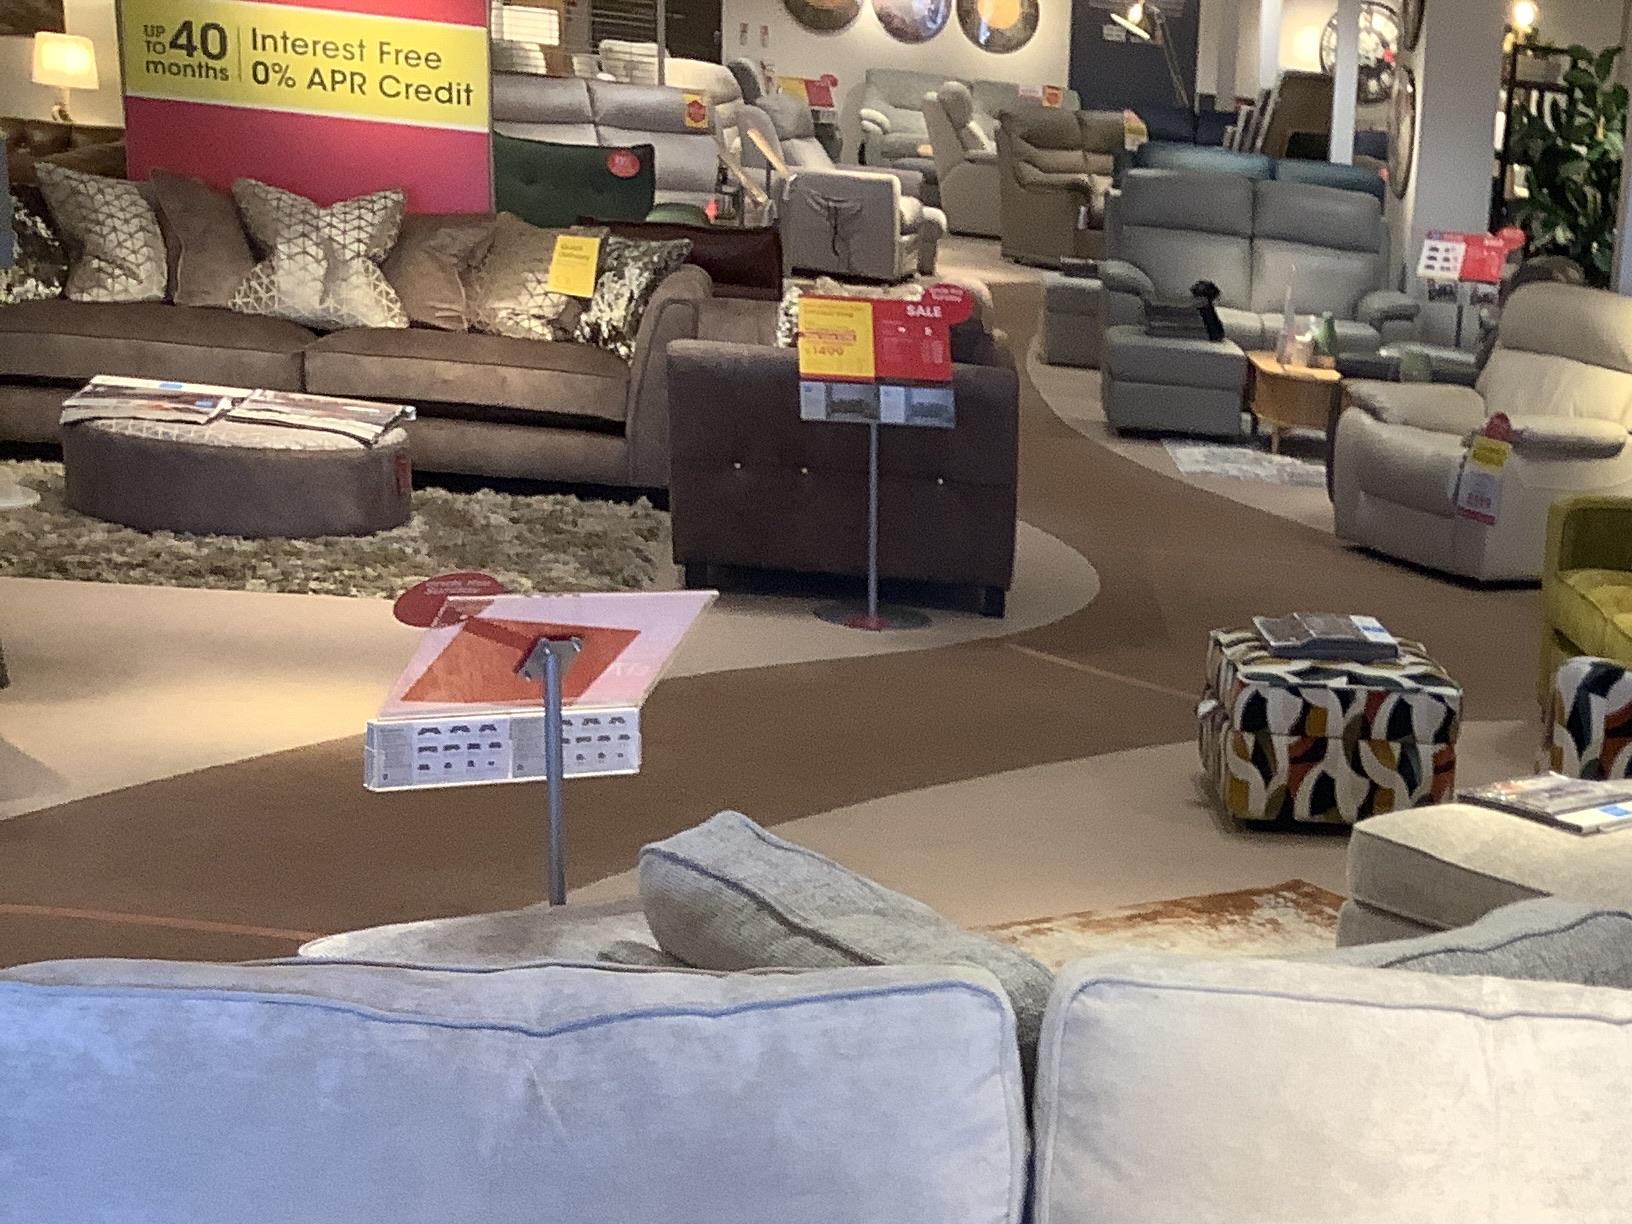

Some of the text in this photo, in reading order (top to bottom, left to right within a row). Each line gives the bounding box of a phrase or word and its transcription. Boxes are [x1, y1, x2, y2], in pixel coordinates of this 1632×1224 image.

[143, 24, 166, 38] UP
[144, 20, 228, 61] TO 40
[251, 27, 443, 70] Interest Free
[145, 60, 230, 81] months
[251, 60, 474, 106] 0% APR Credit
[905, 304, 943, 318] SALE
